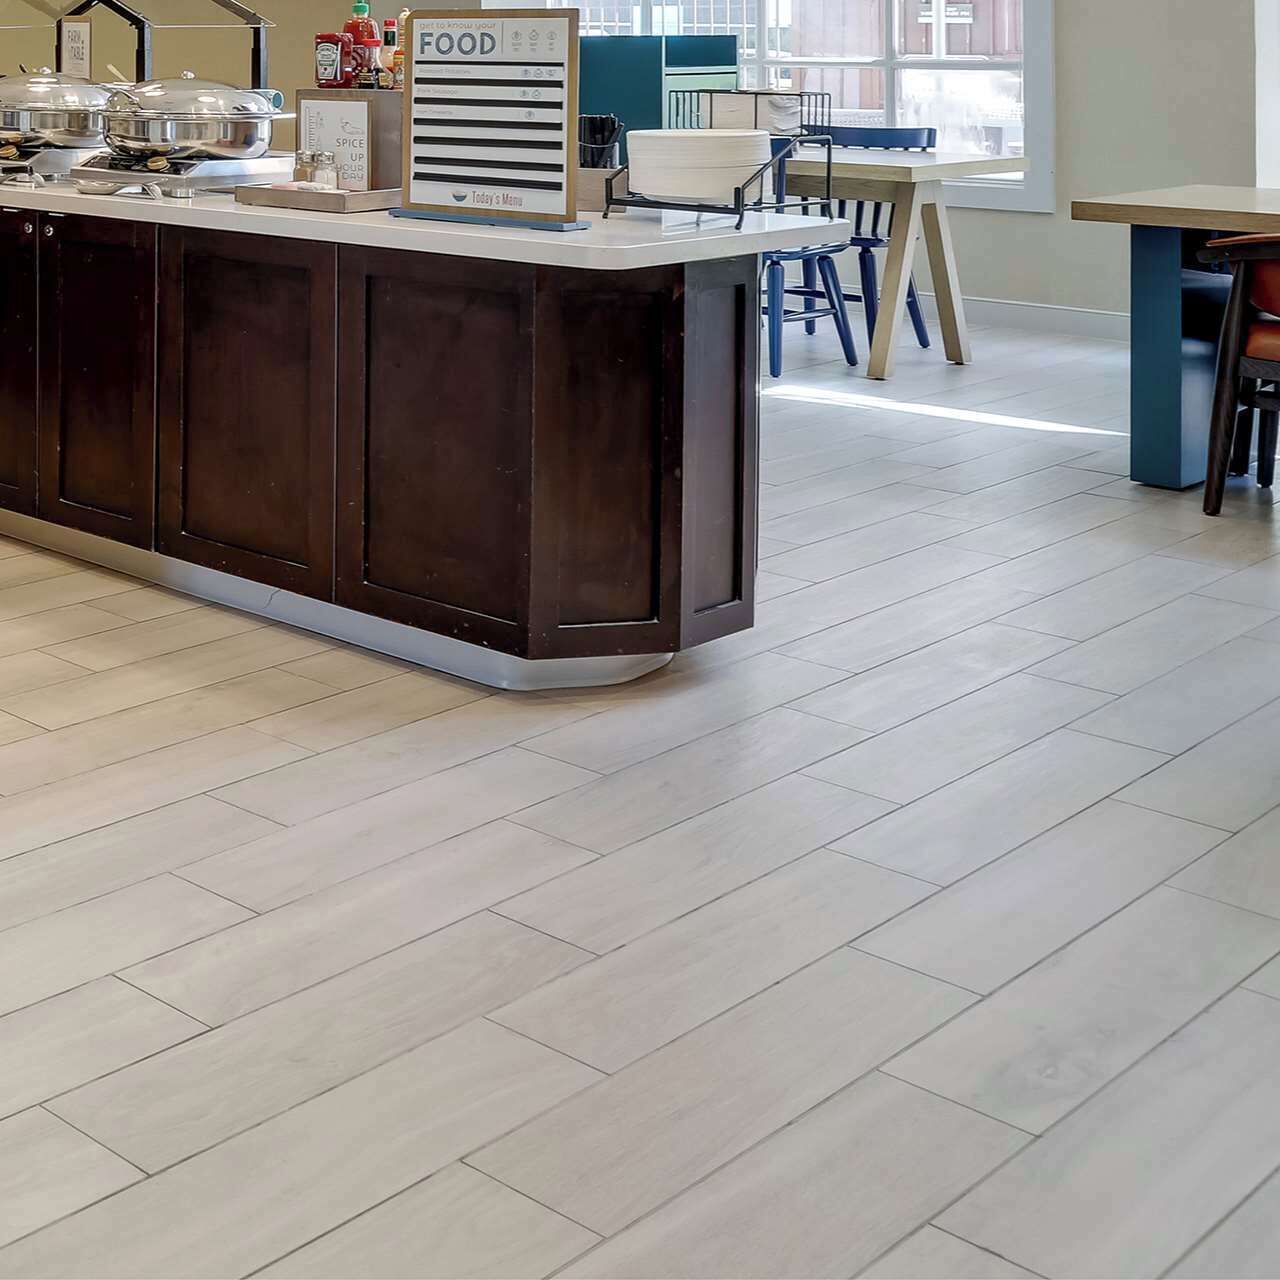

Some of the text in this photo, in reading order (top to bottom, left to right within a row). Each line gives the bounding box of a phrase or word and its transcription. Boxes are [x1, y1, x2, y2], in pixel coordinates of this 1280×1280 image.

[419, 32, 497, 55] FOOD
[336, 138, 365, 148] SPICE
[350, 153, 365, 162] UP
[472, 191, 523, 207] Today's Menu
